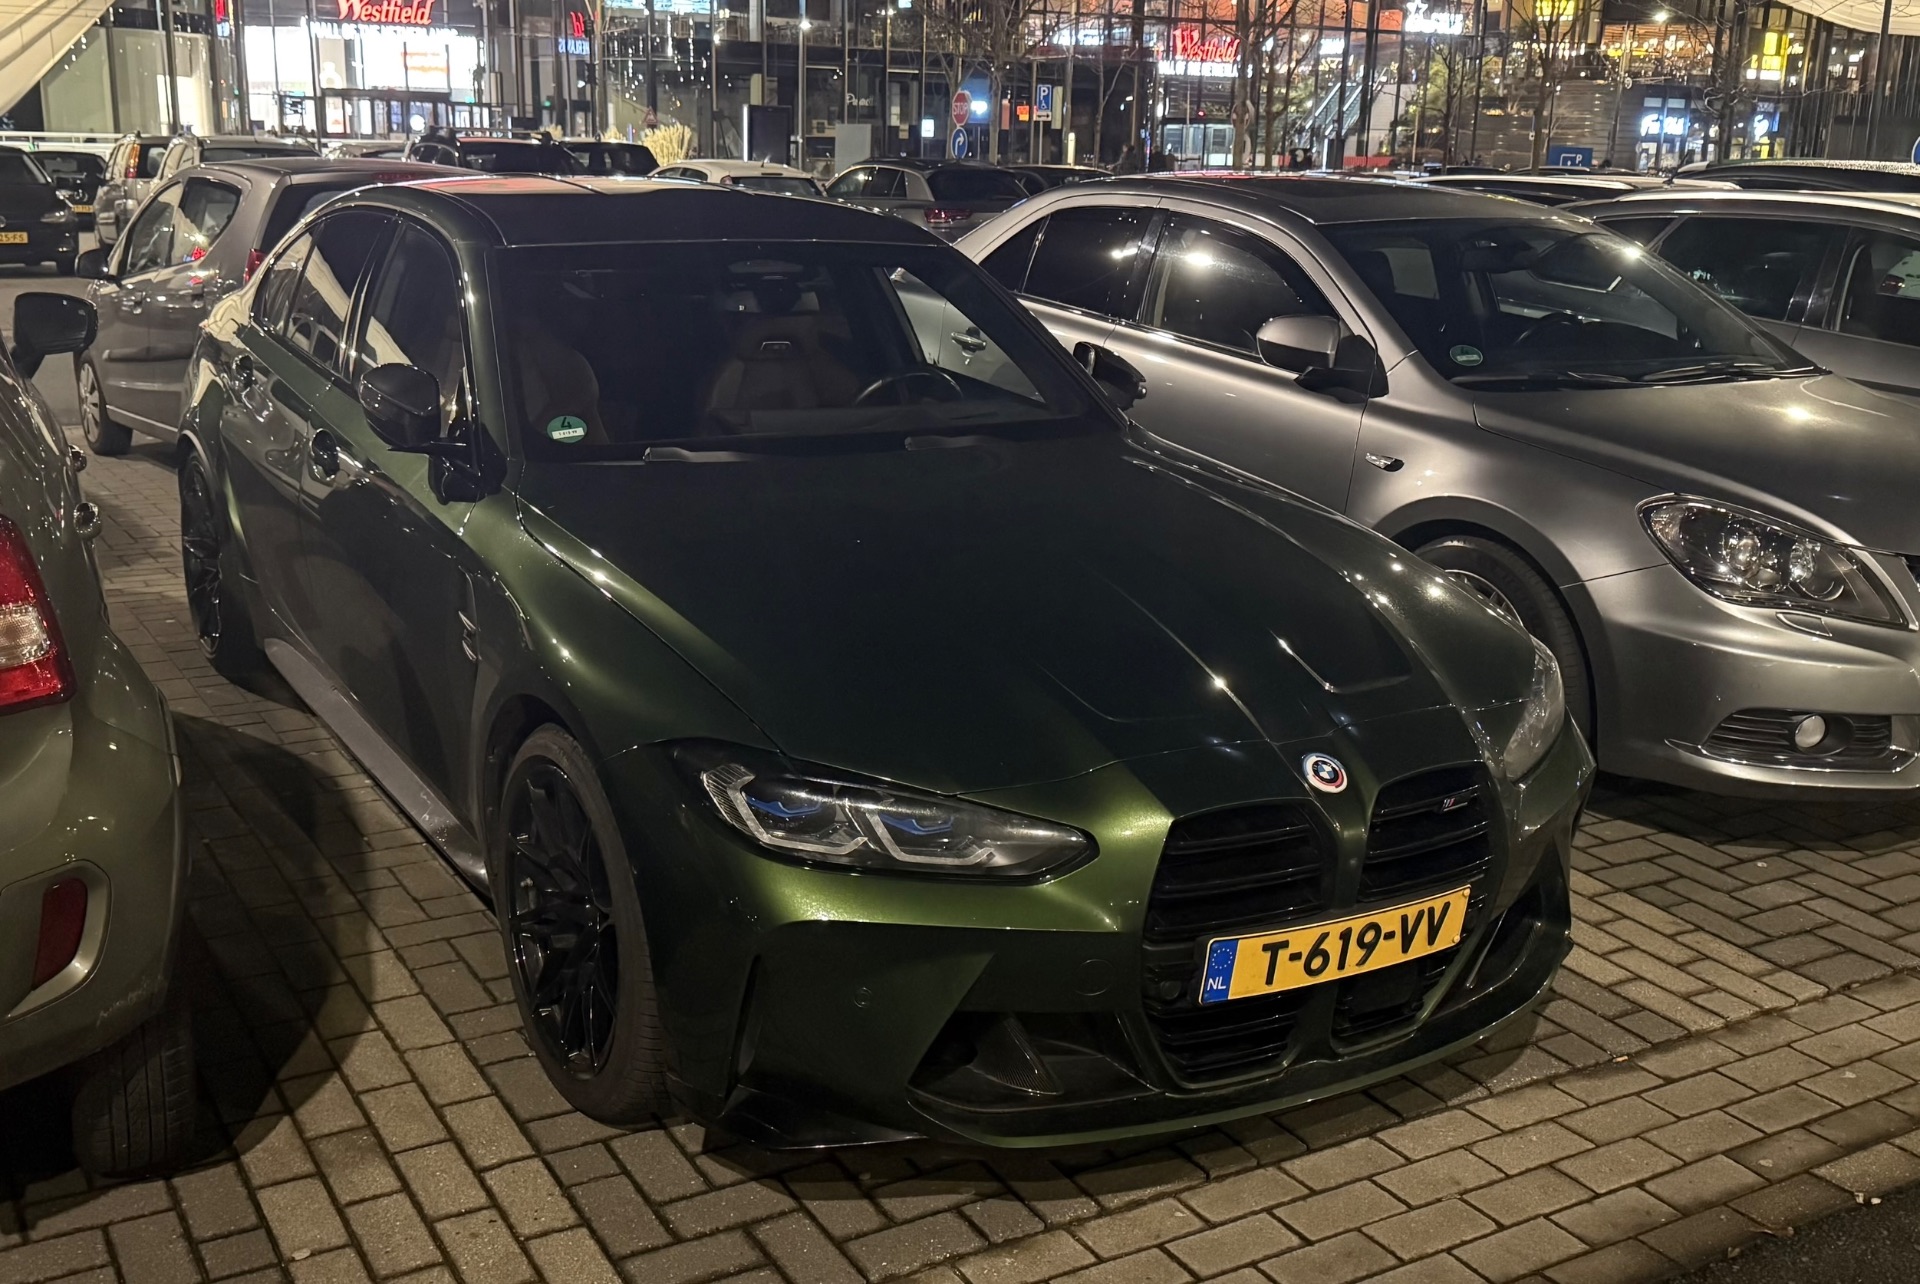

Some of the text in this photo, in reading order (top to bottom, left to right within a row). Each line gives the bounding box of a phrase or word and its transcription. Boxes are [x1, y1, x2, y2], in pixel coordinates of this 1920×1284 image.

[1173, 28, 1240, 62] Westfield
[1040, 87, 1048, 100] P
[953, 102, 968, 115] STOP
[1576, 154, 1583, 164] P
[561, 417, 572, 429] 4
[1262, 901, 1451, 986] T-619-VV
[1207, 976, 1227, 991] NL
